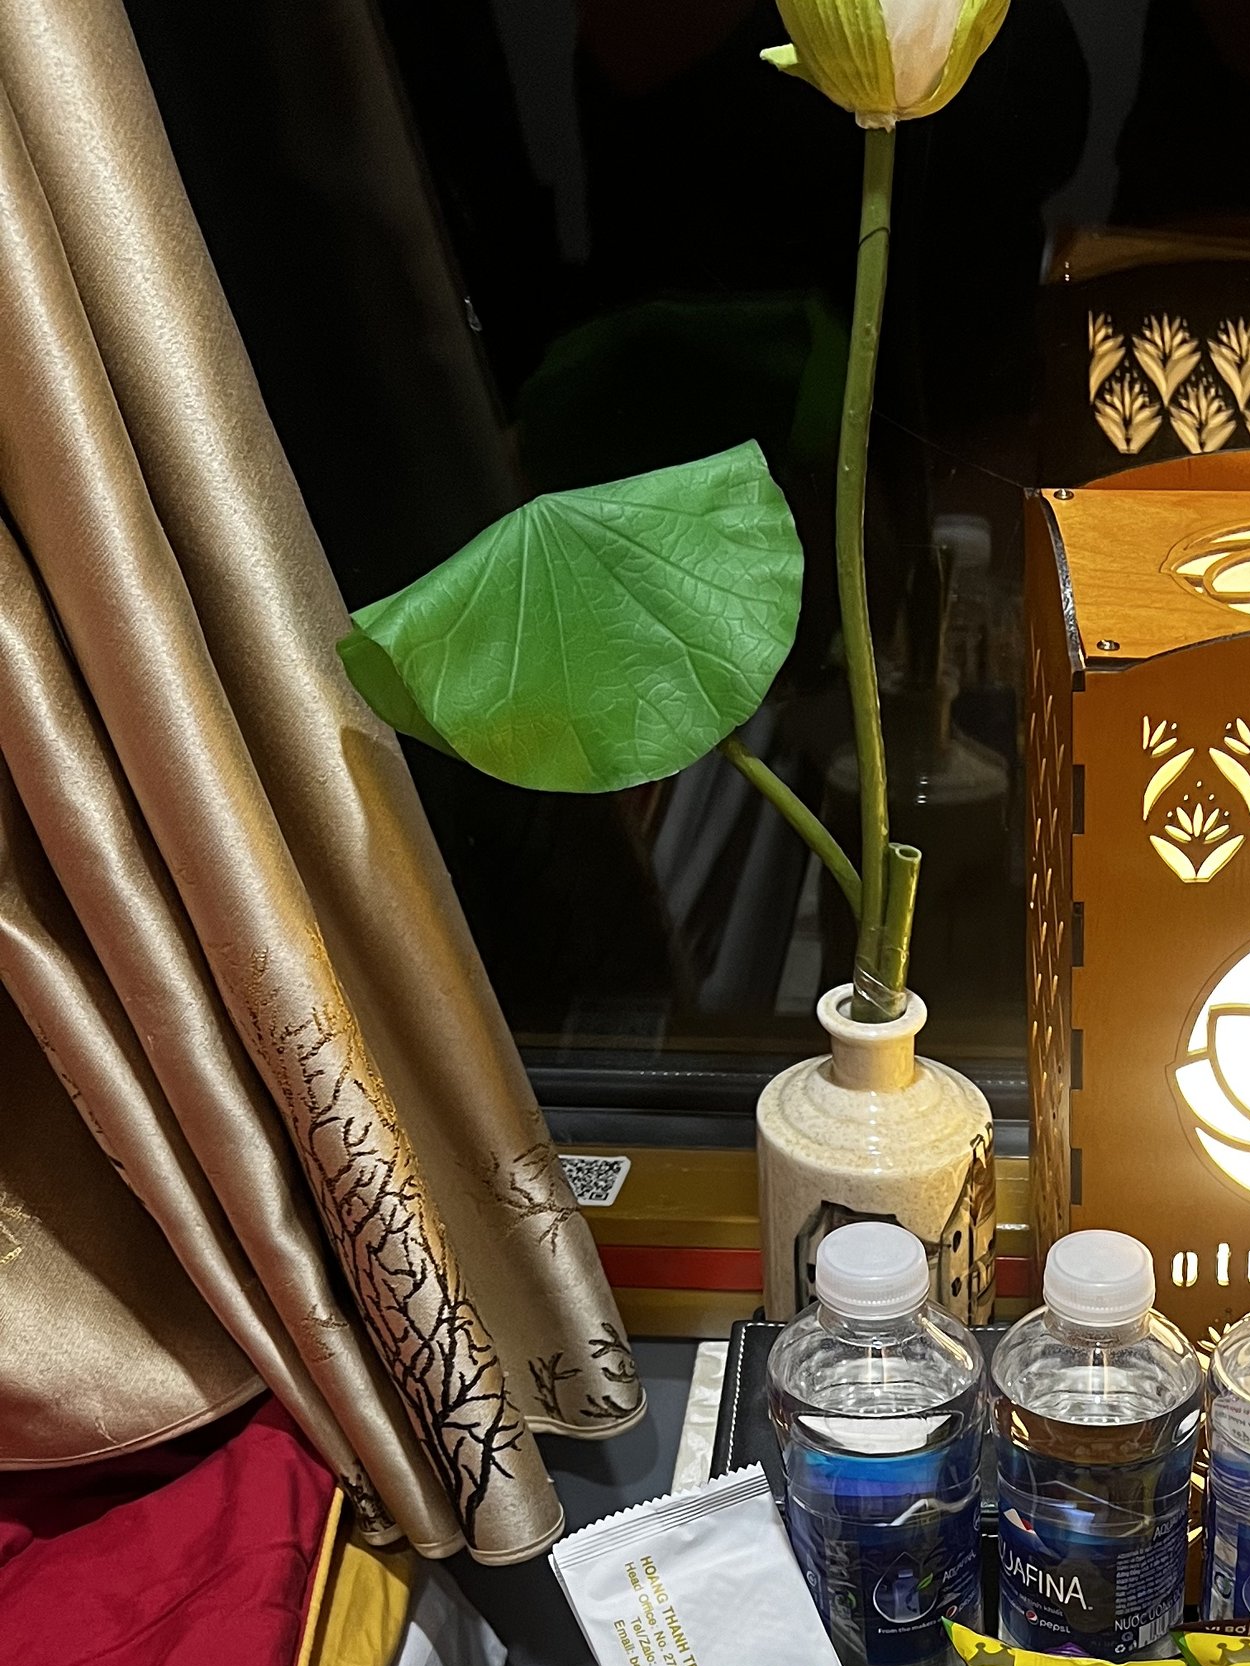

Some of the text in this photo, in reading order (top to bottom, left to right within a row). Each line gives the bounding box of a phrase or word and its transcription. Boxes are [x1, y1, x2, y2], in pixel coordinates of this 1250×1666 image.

[613, 1619, 635, 1656] Email:
[624, 1561, 644, 1593] Head
[638, 1593, 659, 1630] Office:
[654, 1630, 667, 1652] No.
[640, 1555, 669, 1604] HOANG
[662, 1605, 691, 1654] THANH
[630, 1615, 657, 1666] Tel/Zalo:
